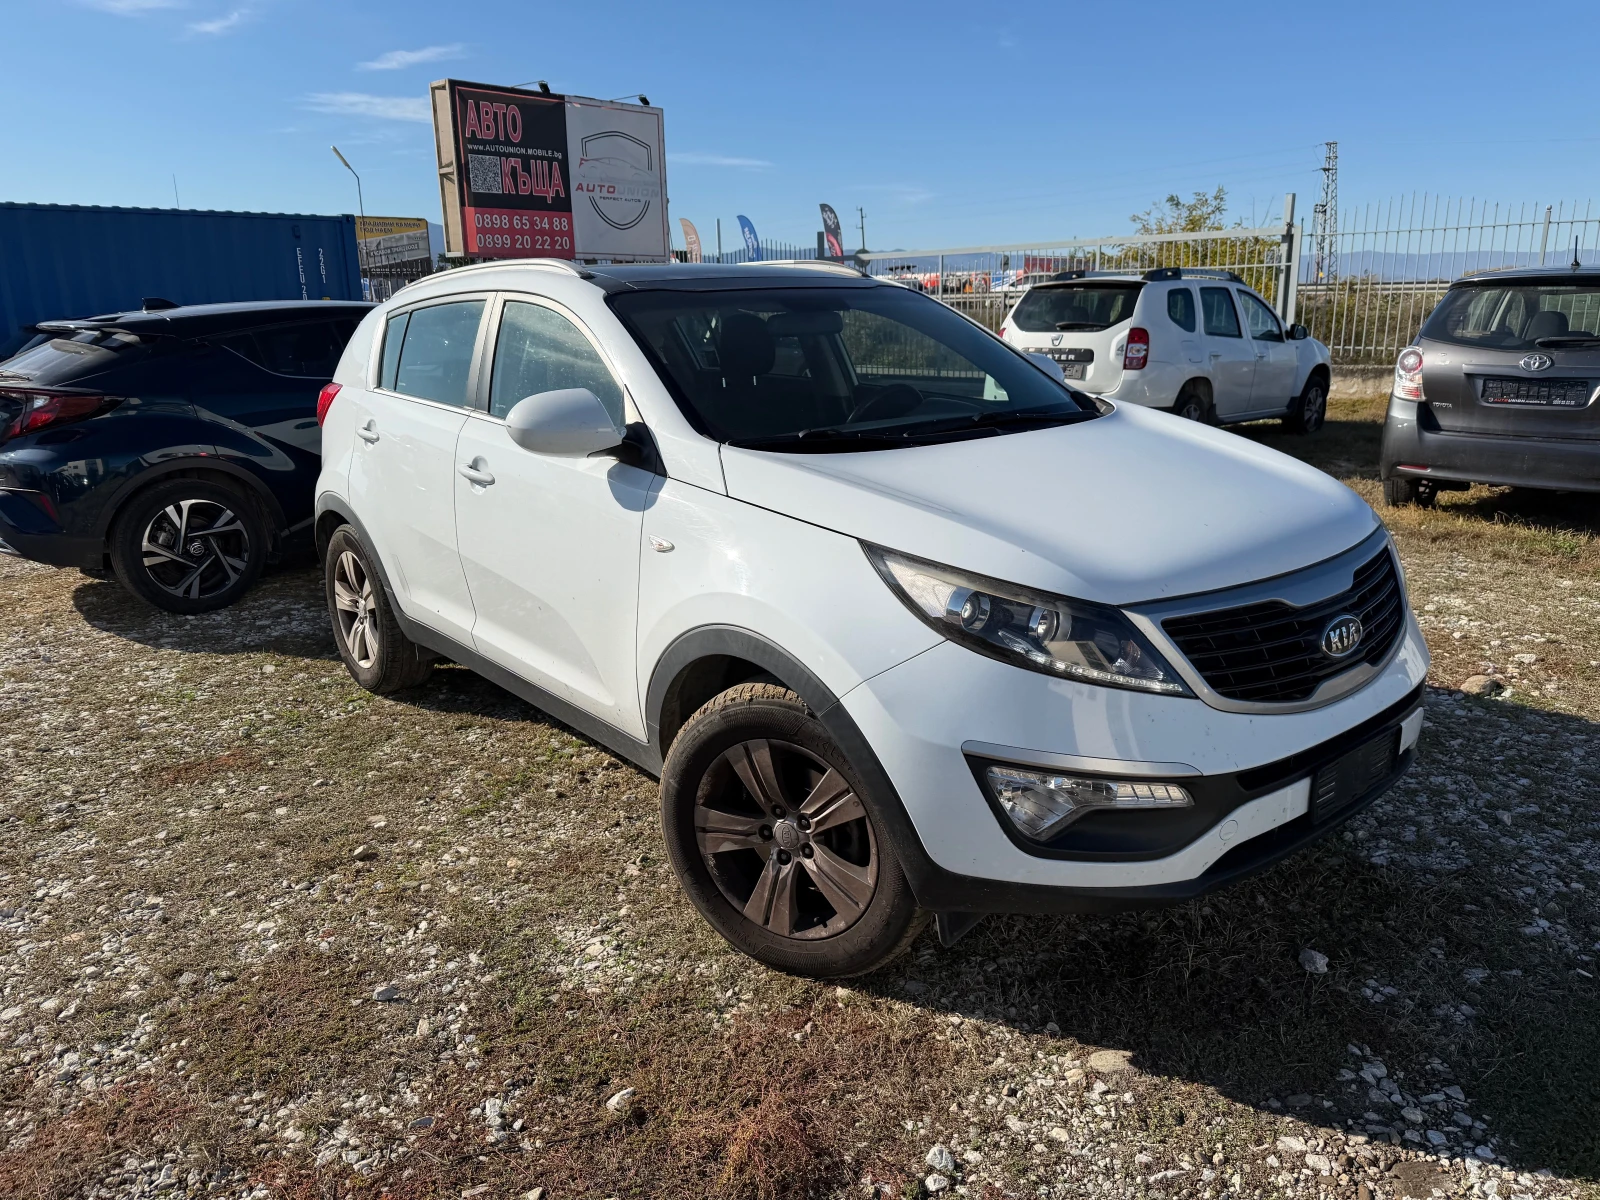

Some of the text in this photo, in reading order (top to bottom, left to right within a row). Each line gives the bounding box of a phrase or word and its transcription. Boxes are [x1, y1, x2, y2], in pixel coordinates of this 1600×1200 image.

[465, 99, 522, 143] АВТО
[467, 143, 562, 159] www.AUTOUNION.MOBILE.bg
[501, 157, 565, 203] КЪЩА
[474, 213, 568, 231] 0898 65 34 88
[476, 233, 570, 250] 0899 20 22 20
[318, 248, 326, 284] 22G1
[1432, 401, 1452, 409] TOYOTA
[1329, 623, 1359, 651] KIA
